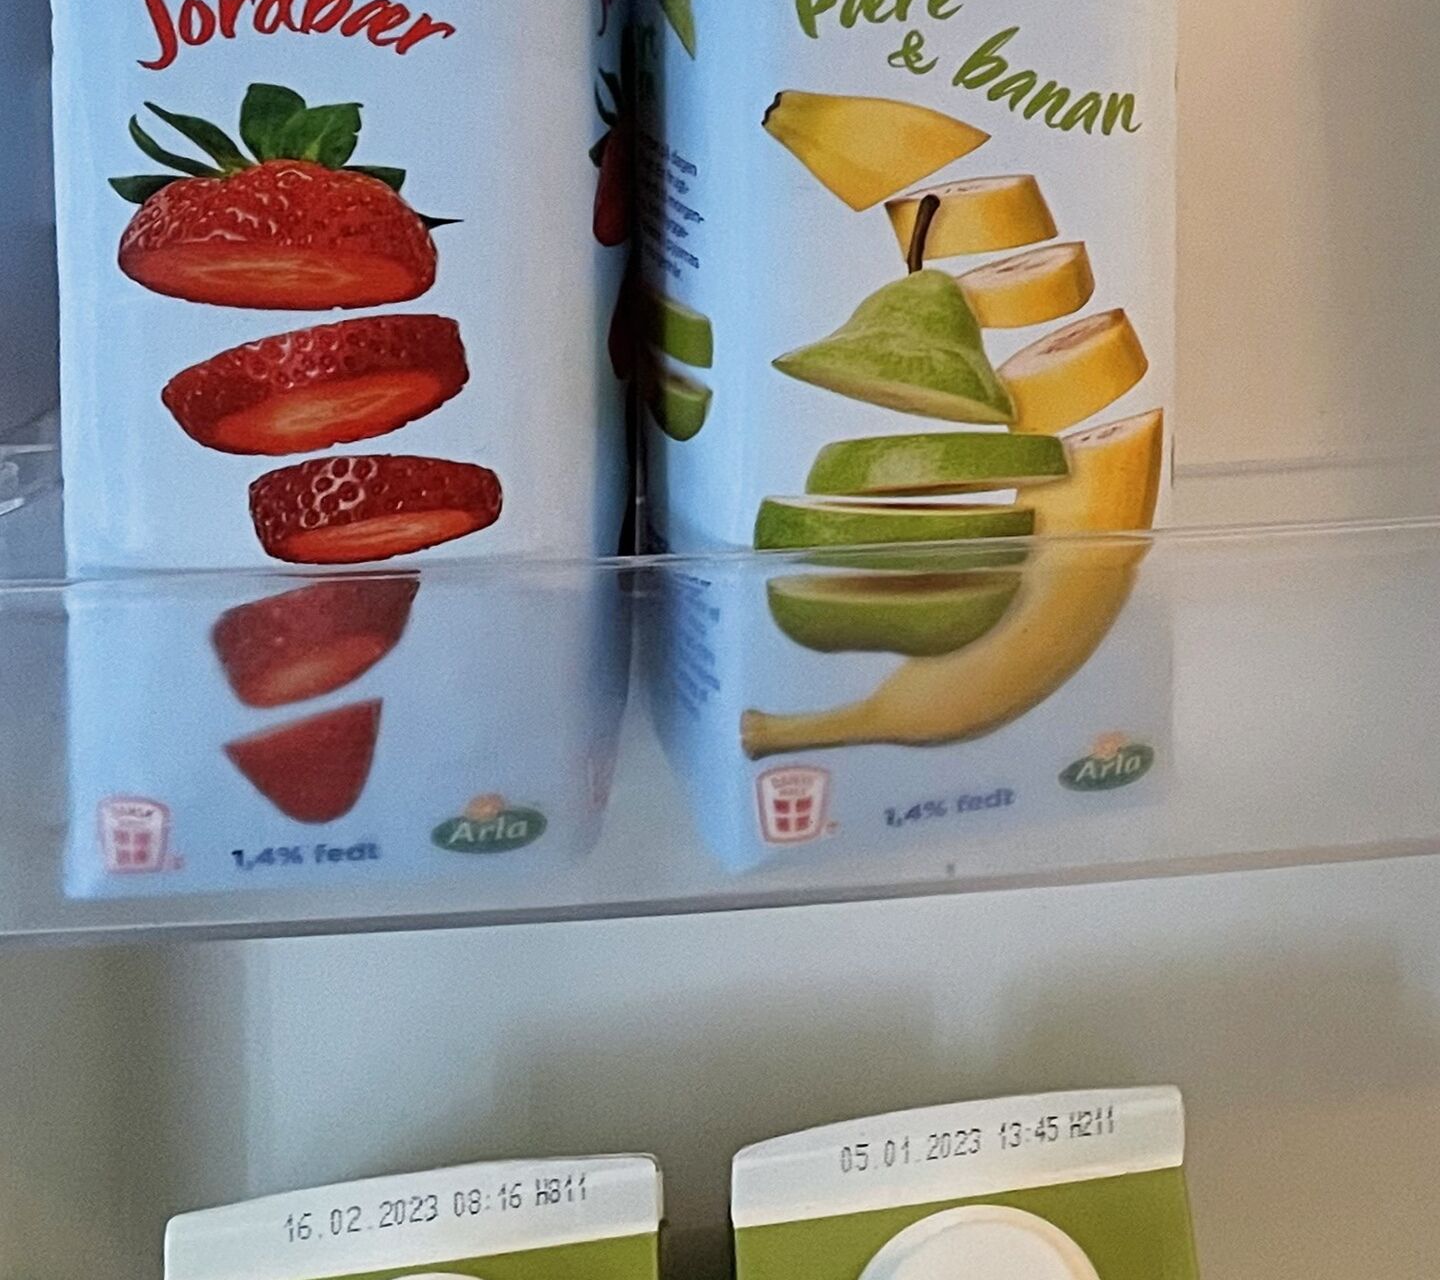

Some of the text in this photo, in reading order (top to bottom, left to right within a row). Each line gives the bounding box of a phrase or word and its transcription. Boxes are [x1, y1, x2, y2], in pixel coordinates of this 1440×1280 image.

[888, 26, 1142, 136] & banan
[1076, 752, 1142, 782] Arla
[449, 812, 529, 846] Arla
[314, 843, 381, 866] fedt
